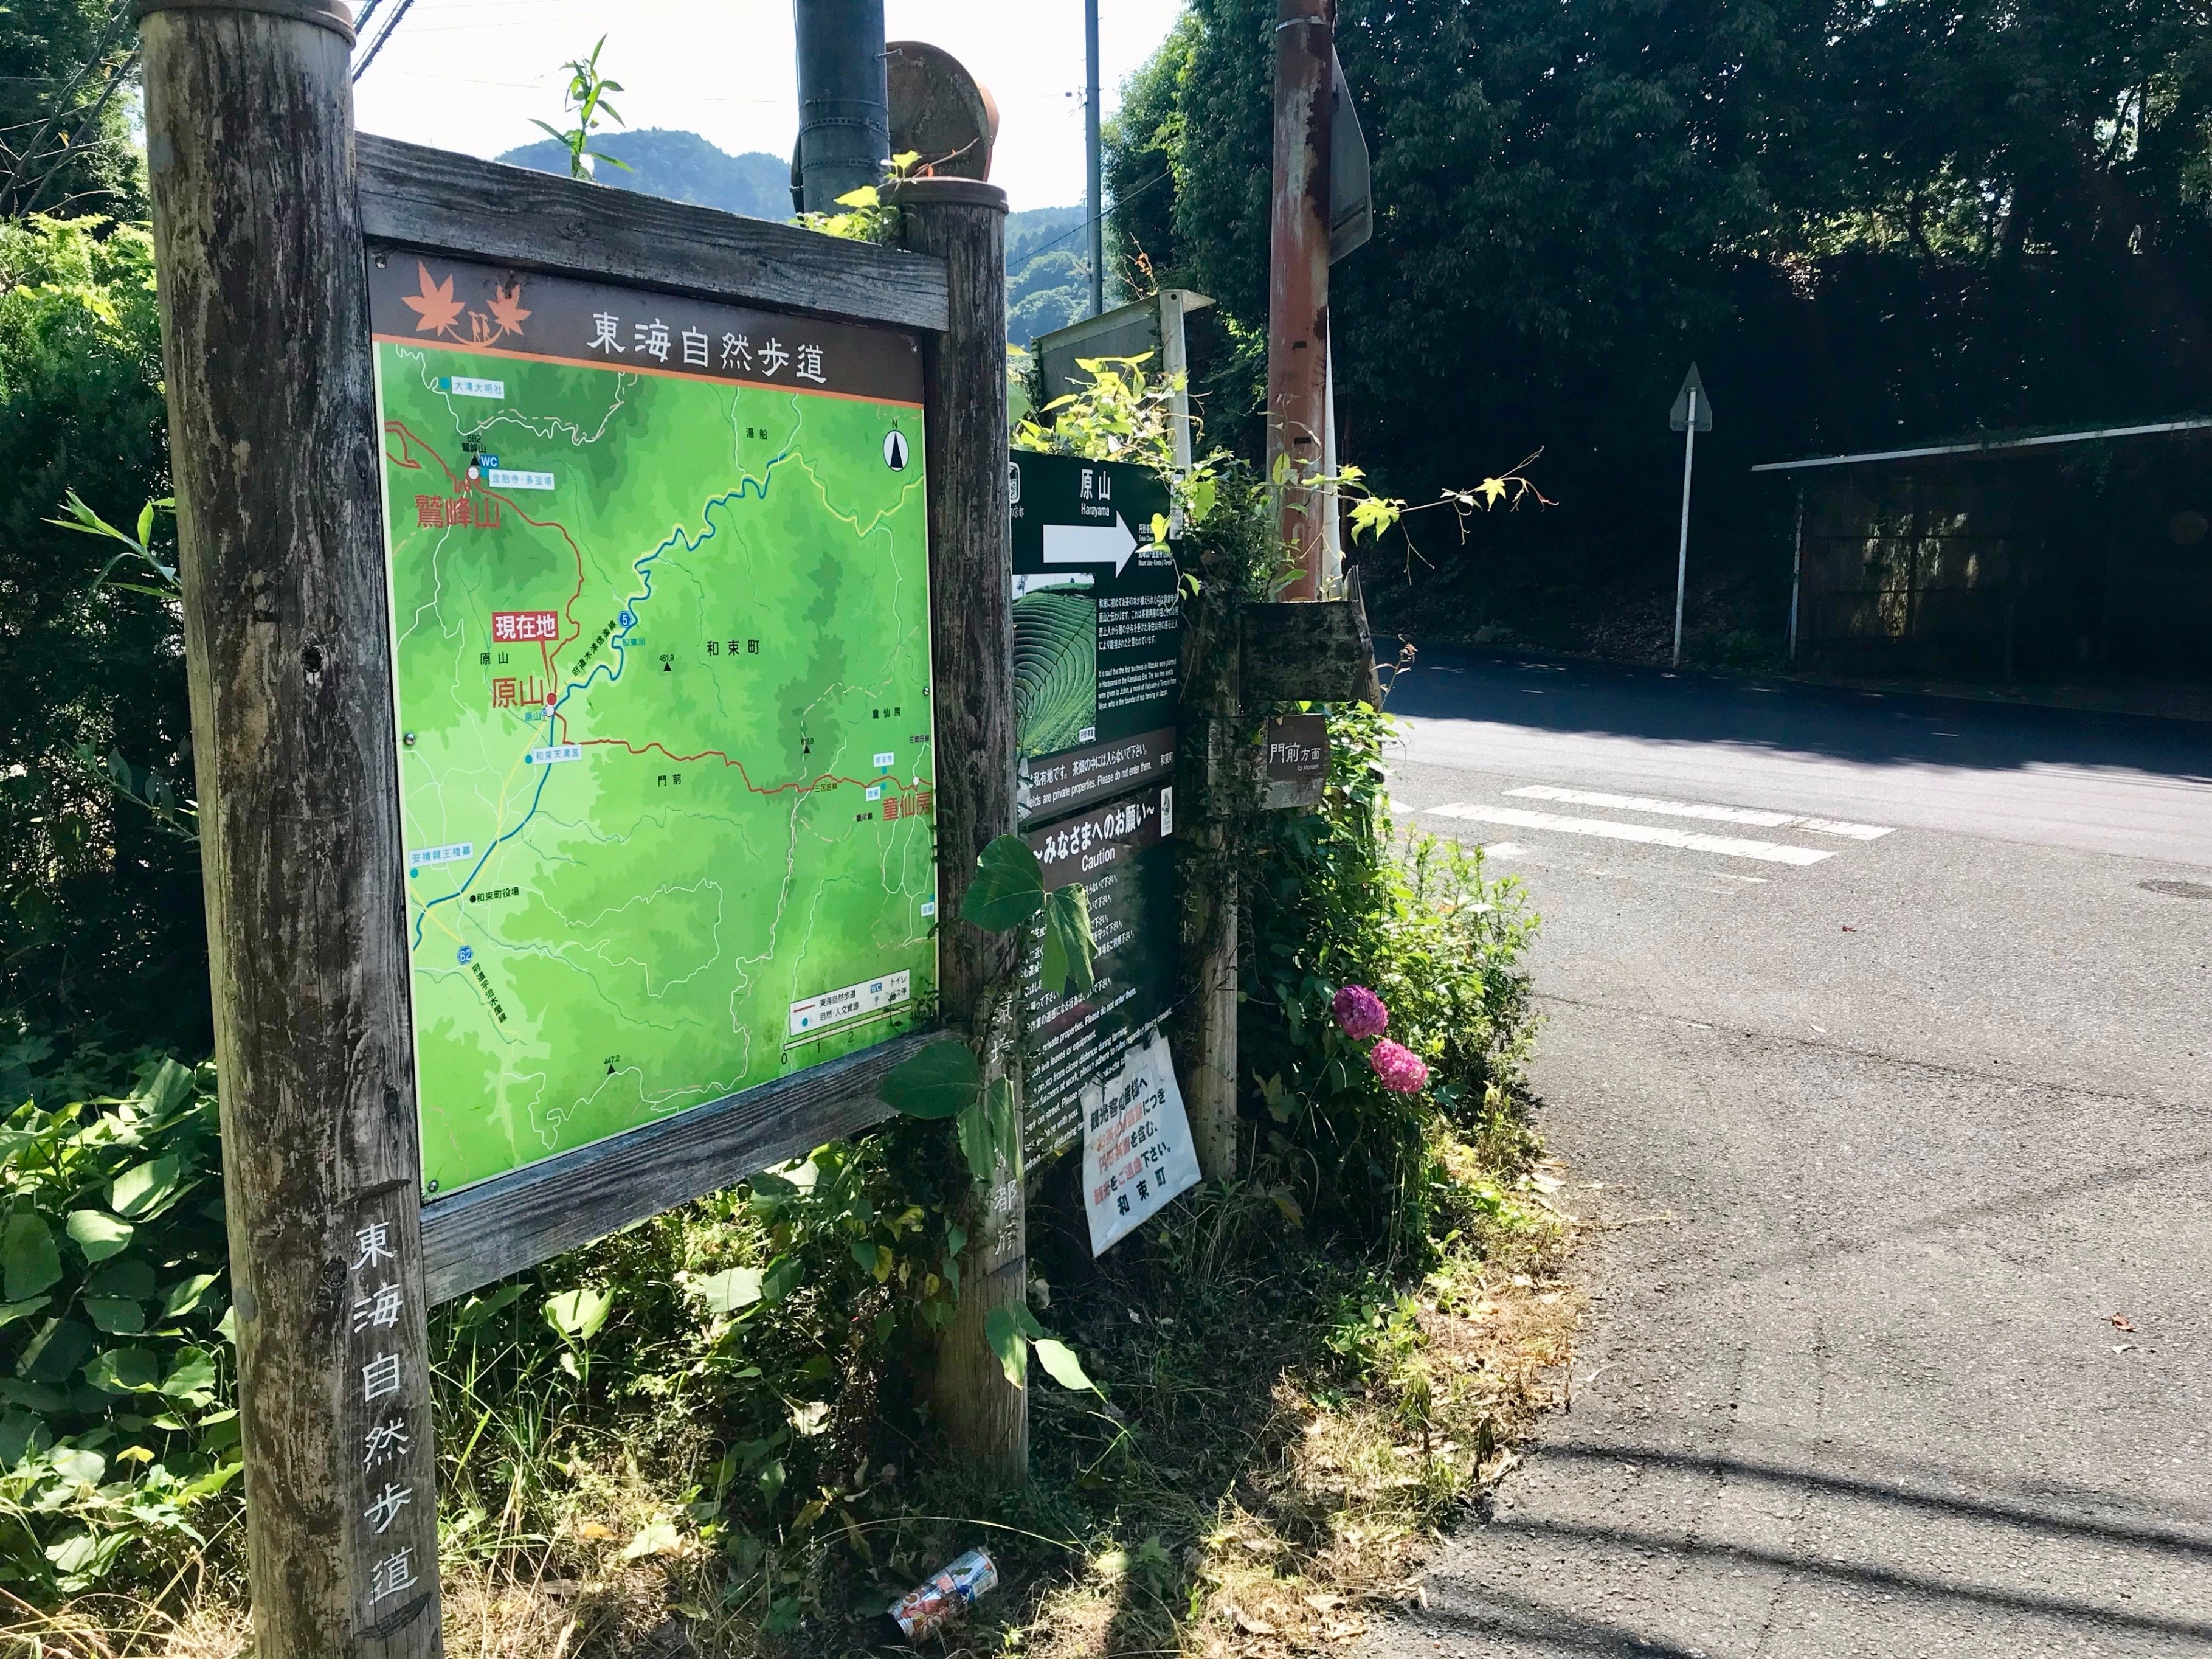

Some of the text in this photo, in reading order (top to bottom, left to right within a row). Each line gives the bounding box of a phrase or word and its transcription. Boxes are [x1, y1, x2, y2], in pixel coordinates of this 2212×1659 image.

[587, 312, 826, 384] 東海自然歩道
[892, 419, 898, 429] N
[467, 434, 482, 443] 682
[480, 457, 497, 468] WC
[1080, 468, 1111, 501] 原山
[415, 494, 500, 530] 鷲峰山
[1080, 503, 1110, 517] Harayama
[495, 614, 556, 639] 現在地
[622, 614, 628, 626] 5
[707, 639, 759, 657] 和束町
[480, 652, 509, 665] 原山
[492, 675, 544, 708] 原山
[872, 707, 901, 719] 童仙房
[536, 748, 579, 761] 和束天満宮
[1071, 744, 1147, 777] 茶畑の中には入らないで下さい。
[1269, 741, 1321, 764] 門前方面
[657, 774, 682, 787] 門前
[1043, 793, 1052, 804] are
[1052, 786, 1070, 803] private
[1097, 773, 1114, 786] Please
[1114, 770, 1121, 780] do
[883, 791, 931, 822] 童仙房
[1081, 846, 1116, 873] Caution
[476, 886, 519, 902] 和束町役場
[459, 949, 471, 962] 62
[870, 983, 882, 993] WC
[890, 976, 907, 986] トイレ
[820, 989, 856, 1008] 東海自然歩道
[820, 1002, 859, 1022] 自然・人文資源
[1085, 1010, 1100, 1026] Please
[1101, 1005, 1106, 1016] do
[781, 1031, 854, 1065] 0 1 2
[1050, 1050, 1066, 1066] leaves
[1094, 1051, 1110, 1067] adhere
[1110, 1047, 1115, 1056] to
[1065, 1059, 1079, 1074] close
[1079, 1047, 1097, 1065] distance
[1037, 1115, 1045, 1125] on
[1061, 1091, 1078, 1109] Please
[1116, 1166, 1166, 1216] 和束町
[349, 1221, 420, 1605] 東海自然歩道
